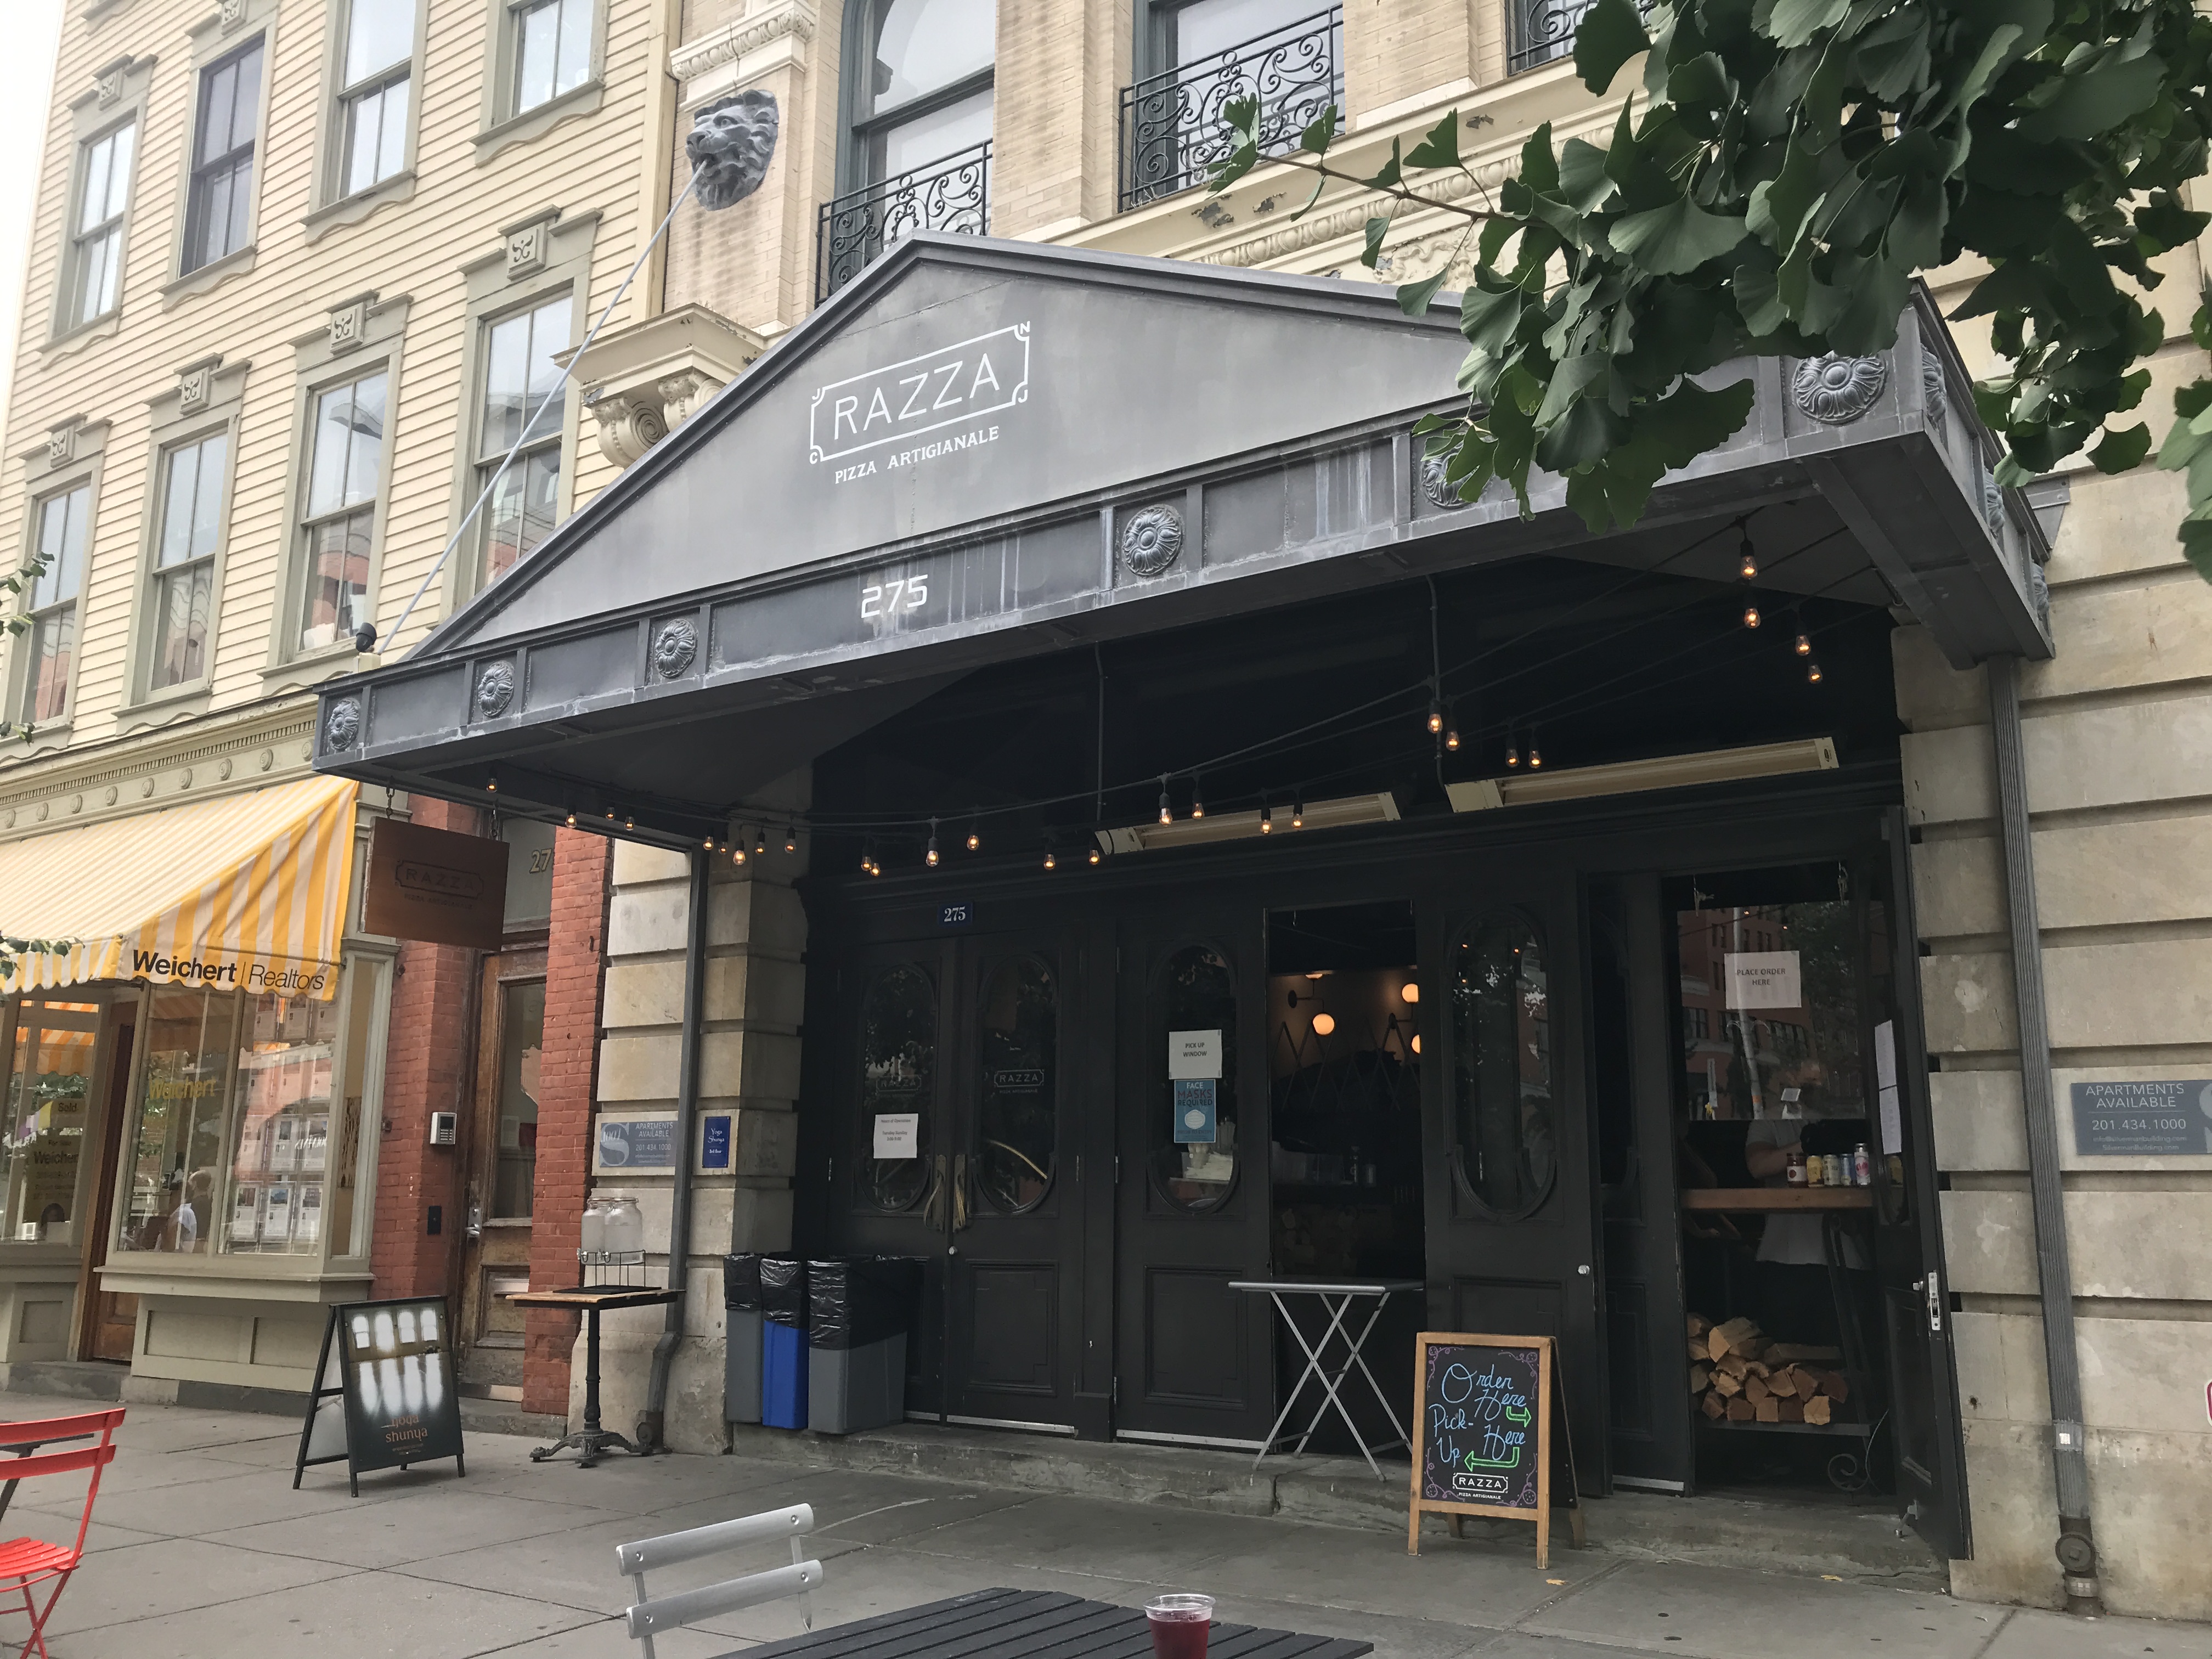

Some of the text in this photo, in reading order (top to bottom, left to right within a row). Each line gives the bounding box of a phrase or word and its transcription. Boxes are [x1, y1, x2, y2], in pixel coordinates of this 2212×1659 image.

[834, 353, 1001, 441] RAZZA
[834, 426, 1000, 484] PIZZA ARTIGIANALE
[861, 574, 928, 619] 275
[529, 848, 553, 874] 27
[405, 867, 474, 890] RAZZA
[944, 906, 966, 922] 275
[133, 949, 325, 990] Weichert Realtors
[1000, 1073, 1039, 1083] RAZZA
[149, 1075, 216, 1101] Weichert
[1177, 1089, 1212, 1099] MASKS
[2085, 1083, 2185, 1096] APARTMENTS
[1177, 1099, 1213, 1107] REQUIRED
[2096, 1096, 2176, 1108] AVAILABLE
[710, 1128, 723, 1136] Yoga
[2092, 1118, 2186, 1131] 201.434.1000
[33, 1150, 78, 1164] Weicher
[1441, 1363, 1514, 1403] Order
[1474, 1388, 1527, 1421] Here
[385, 1427, 428, 1443] shunya
[1482, 1424, 1526, 1461] Here
[1436, 1435, 1461, 1469] Up
[1459, 1477, 1502, 1489] RAZZA
